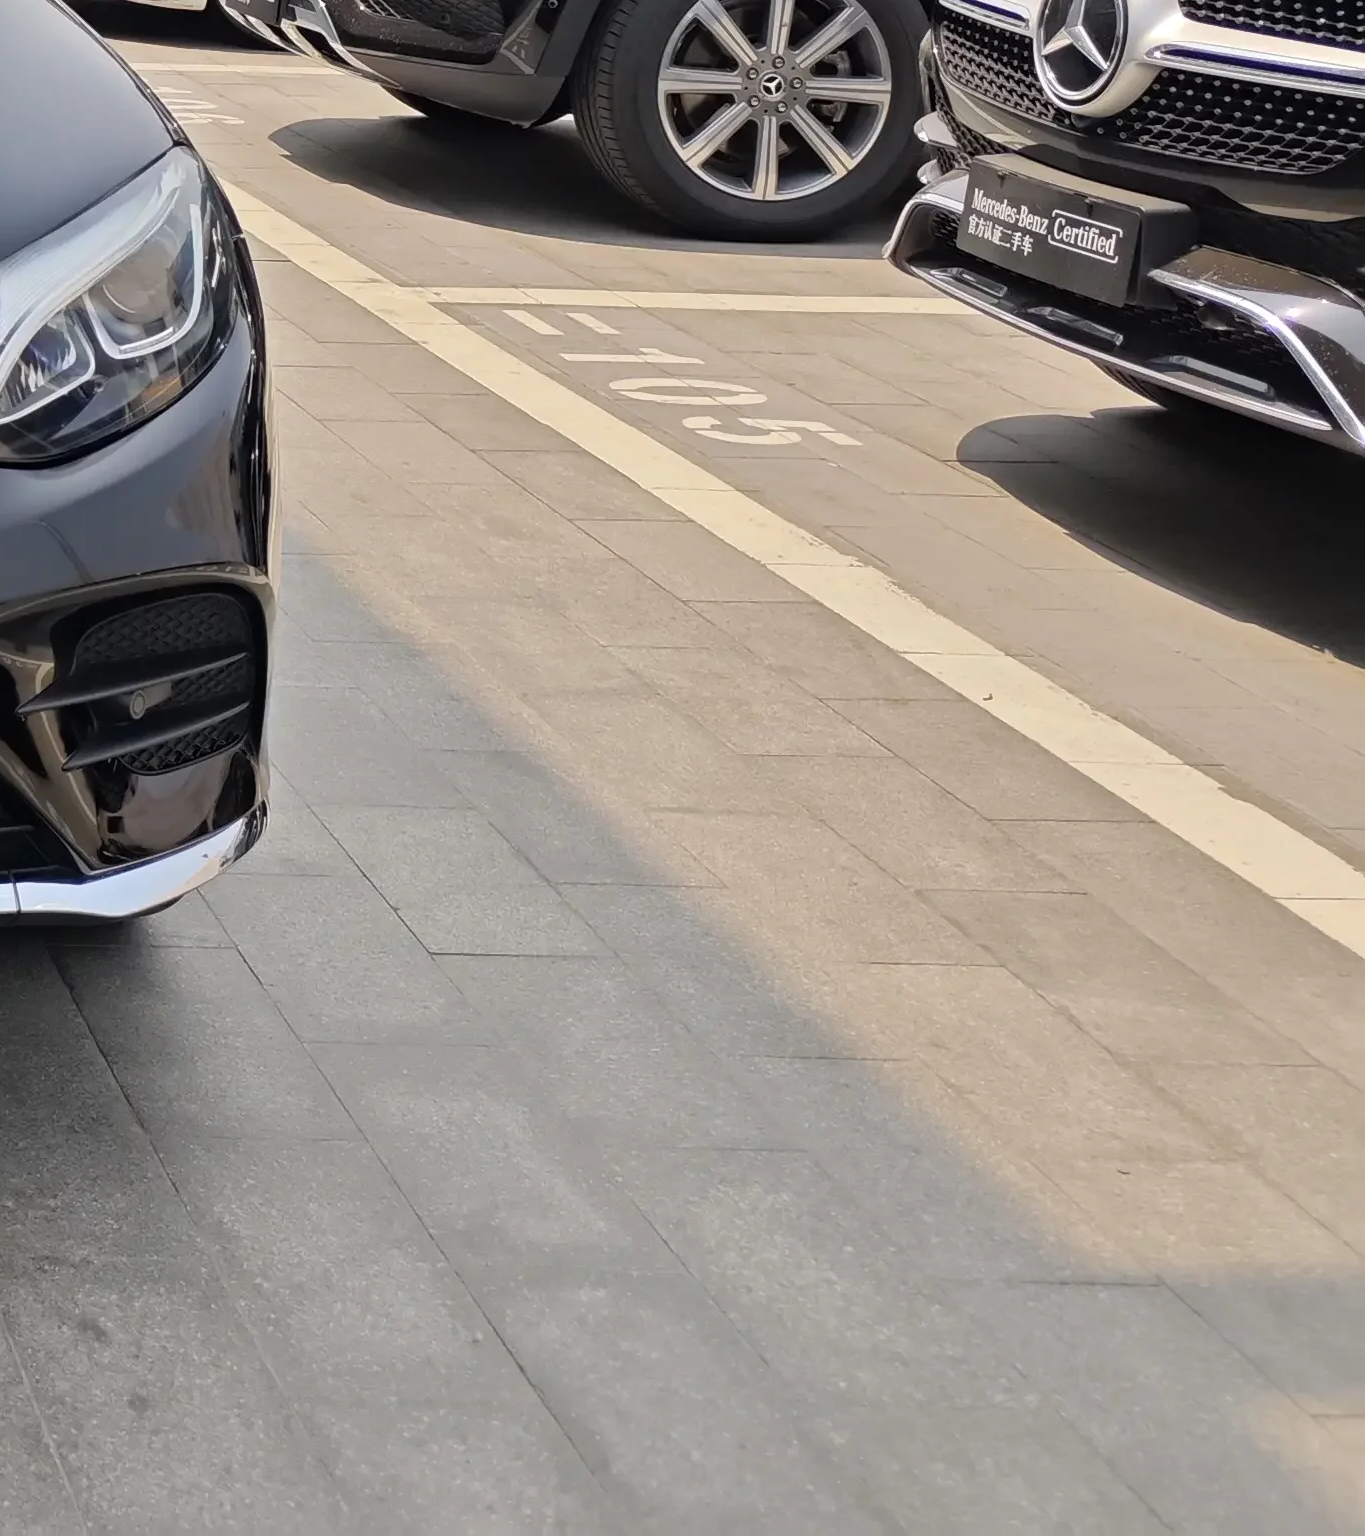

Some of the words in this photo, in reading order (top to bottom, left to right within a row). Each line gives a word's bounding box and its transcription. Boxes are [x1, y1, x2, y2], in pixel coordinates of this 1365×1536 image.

[967, 213, 1034, 257] 官方认证二手车
[971, 187, 1050, 235] Mercedes-Benz
[1053, 216, 1117, 256] Certified
